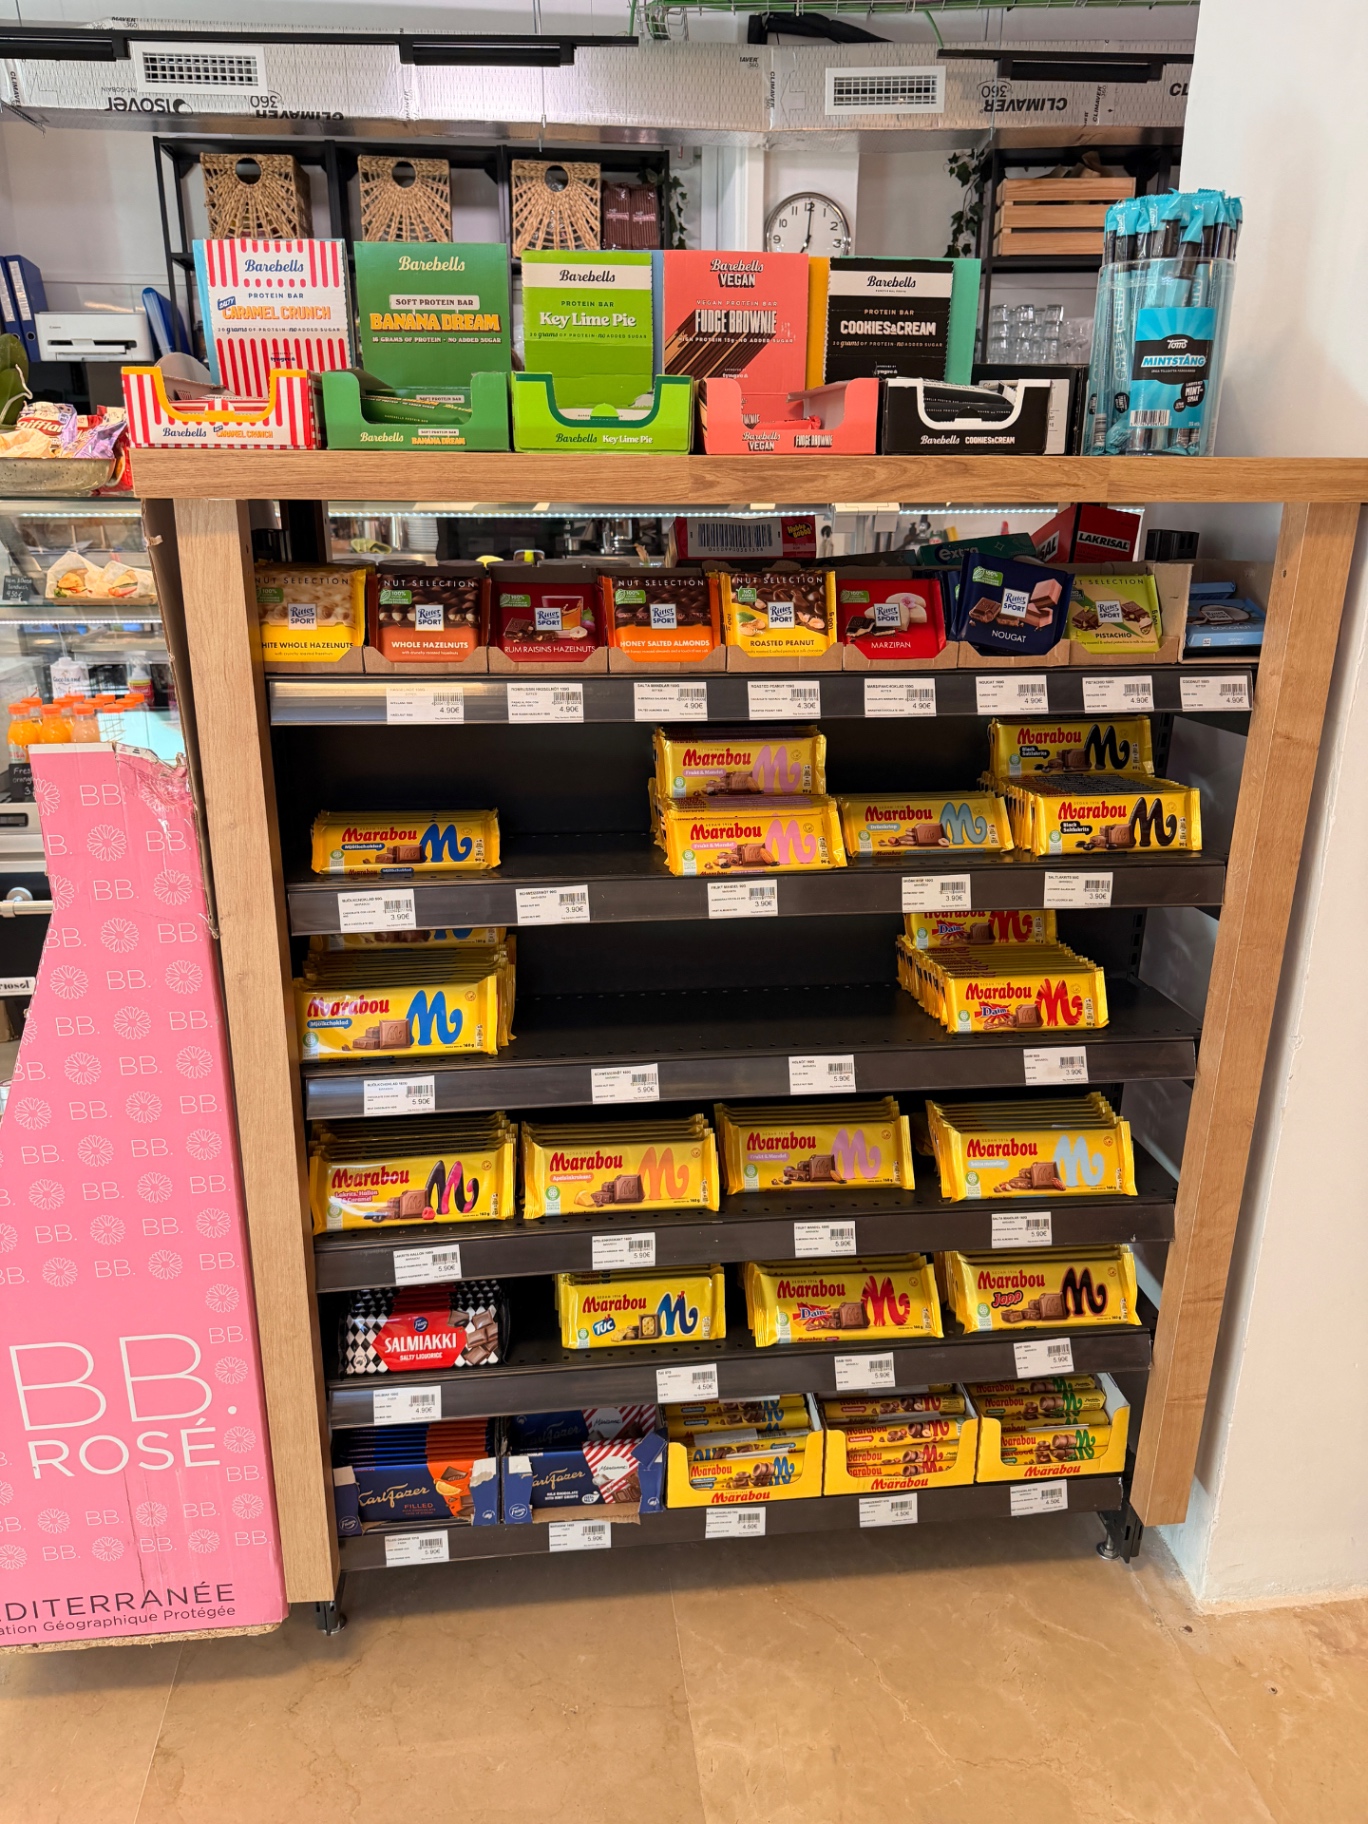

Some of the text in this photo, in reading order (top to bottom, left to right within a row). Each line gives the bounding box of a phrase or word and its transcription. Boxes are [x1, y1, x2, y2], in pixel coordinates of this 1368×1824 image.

[983, 97, 1067, 113] CLIMAVER
[791, 206, 798, 216] 11
[804, 202, 815, 212] 12
[823, 207, 826, 217] 1
[779, 219, 788, 228] 10
[830, 221, 838, 231] 2
[773, 235, 781, 244] 9
[832, 239, 841, 248] 3
[244, 259, 304, 273] Barebells
[399, 256, 465, 272] Barebells
[711, 259, 764, 272] Barebells
[559, 269, 616, 283] Barebells
[719, 273, 756, 288] VEGAN
[866, 275, 916, 288] Barebells
[222, 305, 332, 320] CARAMEL CRUNCH
[369, 313, 501, 333] BANANA DREAM
[539, 312, 636, 329] Key Lime Pie
[694, 310, 777, 334] FUDGE BROWNIE
[840, 320, 936, 336] COOKIES&CREAM
[1141, 354, 1207, 368] MINTSTÅNG
[162, 427, 207, 438] Barebells
[360, 432, 404, 443] Barebells
[555, 433, 653, 445] Barebells Key Lime Pie
[742, 432, 780, 441] Barebells
[748, 441, 775, 451] VEGAN
[920, 435, 960, 445] Barebells
[1078, 533, 1130, 551] LAKRISAL
[411, 580, 475, 588] SELECTION
[618, 579, 704, 587] NUT SELECTION
[736, 576, 823, 584] NUT SELECTION
[290, 607, 314, 618] Ritter
[770, 605, 792, 616] Ritter
[1003, 602, 1026, 613] SPORT
[290, 617, 316, 625] SPORT
[991, 629, 1027, 643] NOUGAT
[1095, 631, 1133, 640] PISTACHIO
[391, 641, 469, 649] WHOLE HAZELNUTS
[504, 646, 525, 654] RUM
[553, 645, 596, 653] HAZELNUTS
[673, 639, 710, 647] ALMONDS
[785, 639, 815, 647] PEANUT
[870, 641, 912, 650] MARZIPAN
[797, 702, 816, 710] 4.30€
[913, 702, 931, 710] 4.90€
[1130, 696, 1149, 704] 4.90€
[440, 706, 460, 714] 4.90€
[559, 705, 580, 713] 4.90€
[1017, 727, 1082, 745] Marabou
[683, 747, 752, 767] Marabou
[79, 784, 127, 806] BB.
[1058, 800, 1127, 820] Marabou
[342, 827, 418, 842] Marabou
[690, 822, 762, 841] Marabou
[1089, 892, 1107, 900] 3.90€
[390, 913, 410, 921] 3.90€
[106, 969, 152, 990] BB.
[965, 982, 1032, 1001] Marabou
[307, 994, 390, 1018] Marabou
[119, 1055, 163, 1076] BB.
[411, 1097, 431, 1106] 5.90€
[747, 1131, 817, 1151] Marabou
[967, 1138, 1038, 1158] Marabou
[549, 1151, 623, 1172] Marabou
[633, 1251, 651, 1260] 5.90€
[777, 1280, 846, 1299] Marabou
[582, 1294, 647, 1313] Marabou
[595, 1320, 615, 1334] TUC
[384, 1332, 457, 1353] SALMIAKKI
[419, 1351, 443, 1360] LIQUORICE
[9, 1333, 238, 1433] BB.
[27, 1418, 221, 1480] ROSÉ
[870, 1477, 929, 1491] Marabou
[711, 1490, 771, 1504] Marabou
[0, 1582, 236, 1622] DITERRANÉE
[43, 1610, 158, 1634] Géographique
[163, 1604, 236, 1624] Protégée
